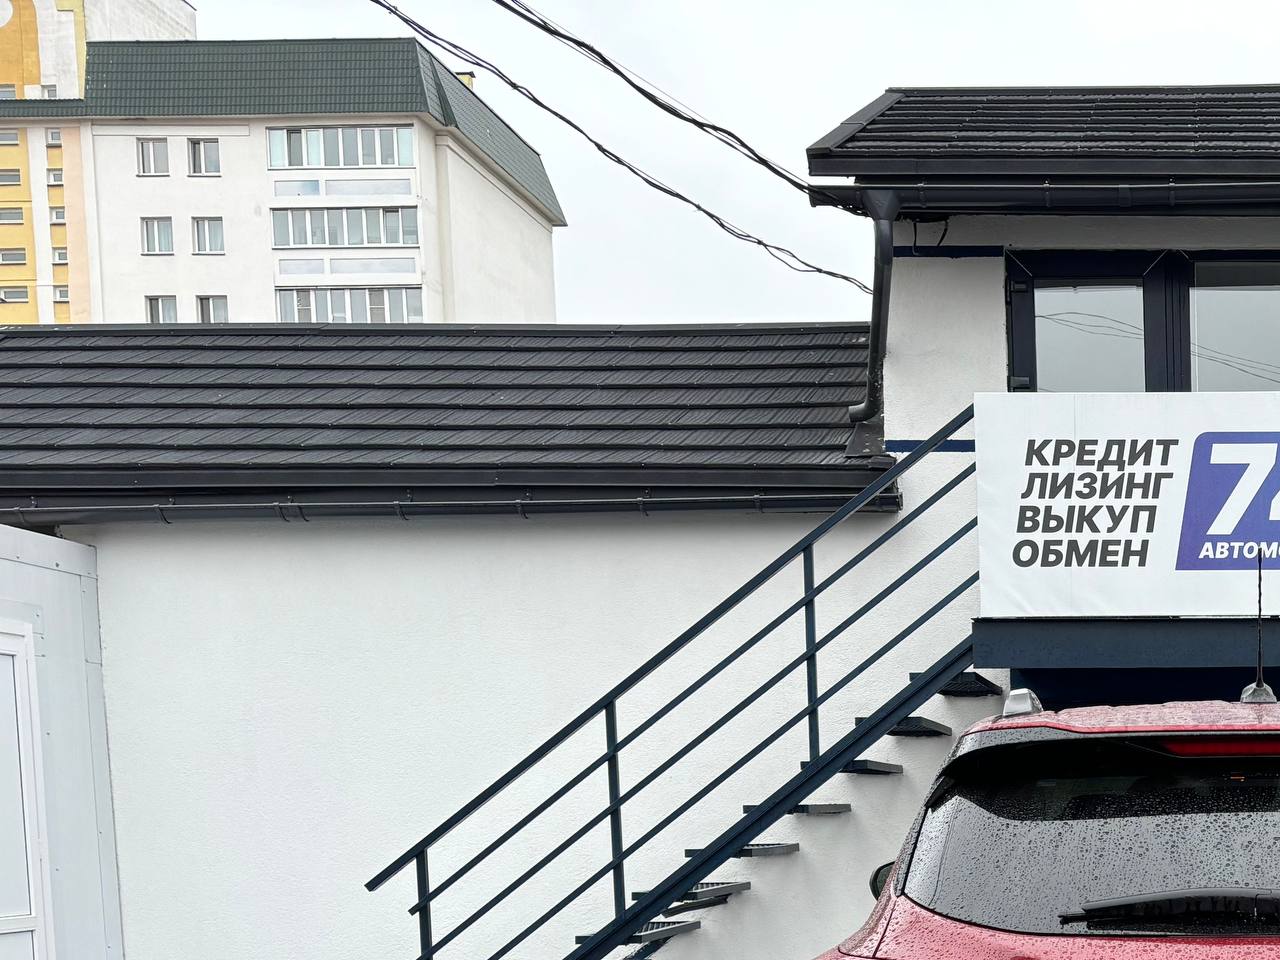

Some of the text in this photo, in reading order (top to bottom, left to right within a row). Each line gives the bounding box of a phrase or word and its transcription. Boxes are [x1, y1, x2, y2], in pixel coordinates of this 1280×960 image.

[1025, 439, 1179, 472] КРЕДИТ
[1020, 472, 1174, 499] ЛИЗИНГ
[1016, 505, 1157, 533] ВЫКУП
[1012, 539, 1149, 568] ОБМЕН
